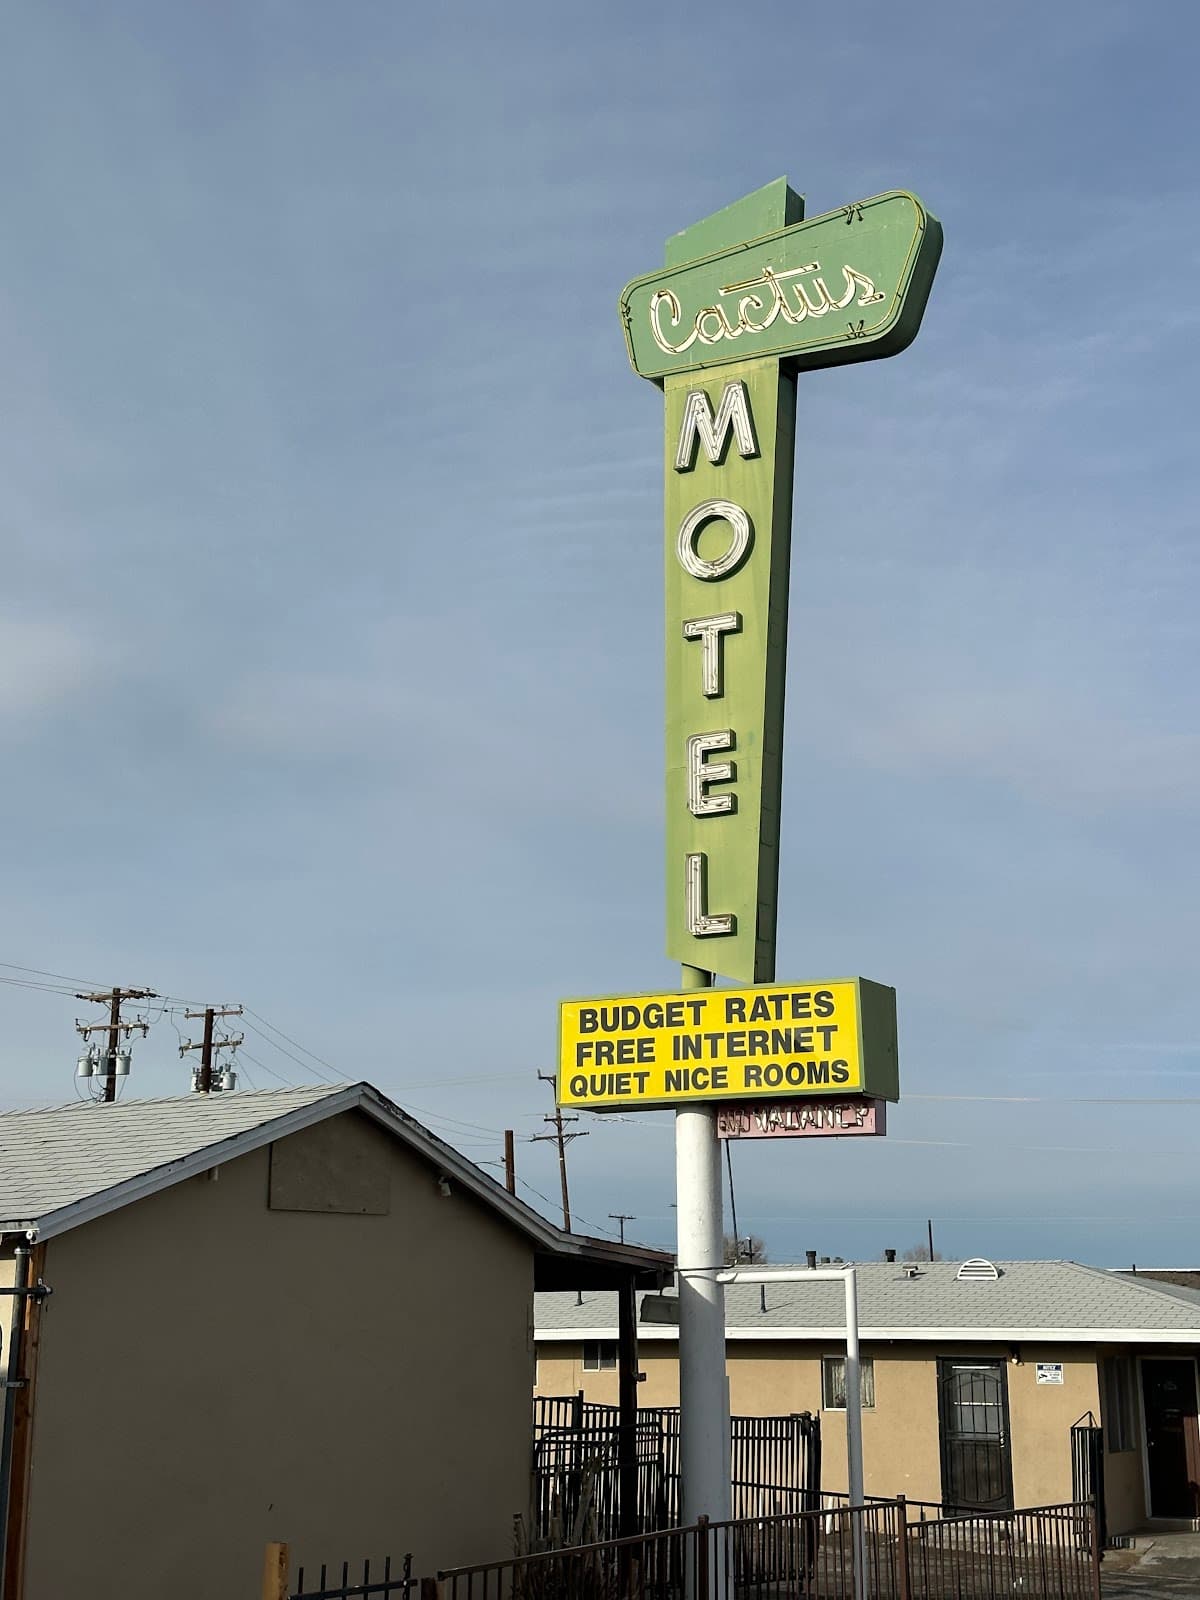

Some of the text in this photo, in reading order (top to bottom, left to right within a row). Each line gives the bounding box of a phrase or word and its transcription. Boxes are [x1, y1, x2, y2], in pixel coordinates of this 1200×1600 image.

[649, 261, 885, 354] Cactus
[674, 380, 760, 939] MOTEL
[579, 990, 835, 1033] BUDGET RATES
[576, 1025, 838, 1067] FREE INTERNET
[569, 1059, 850, 1098] QUIET NICE ROOMS
